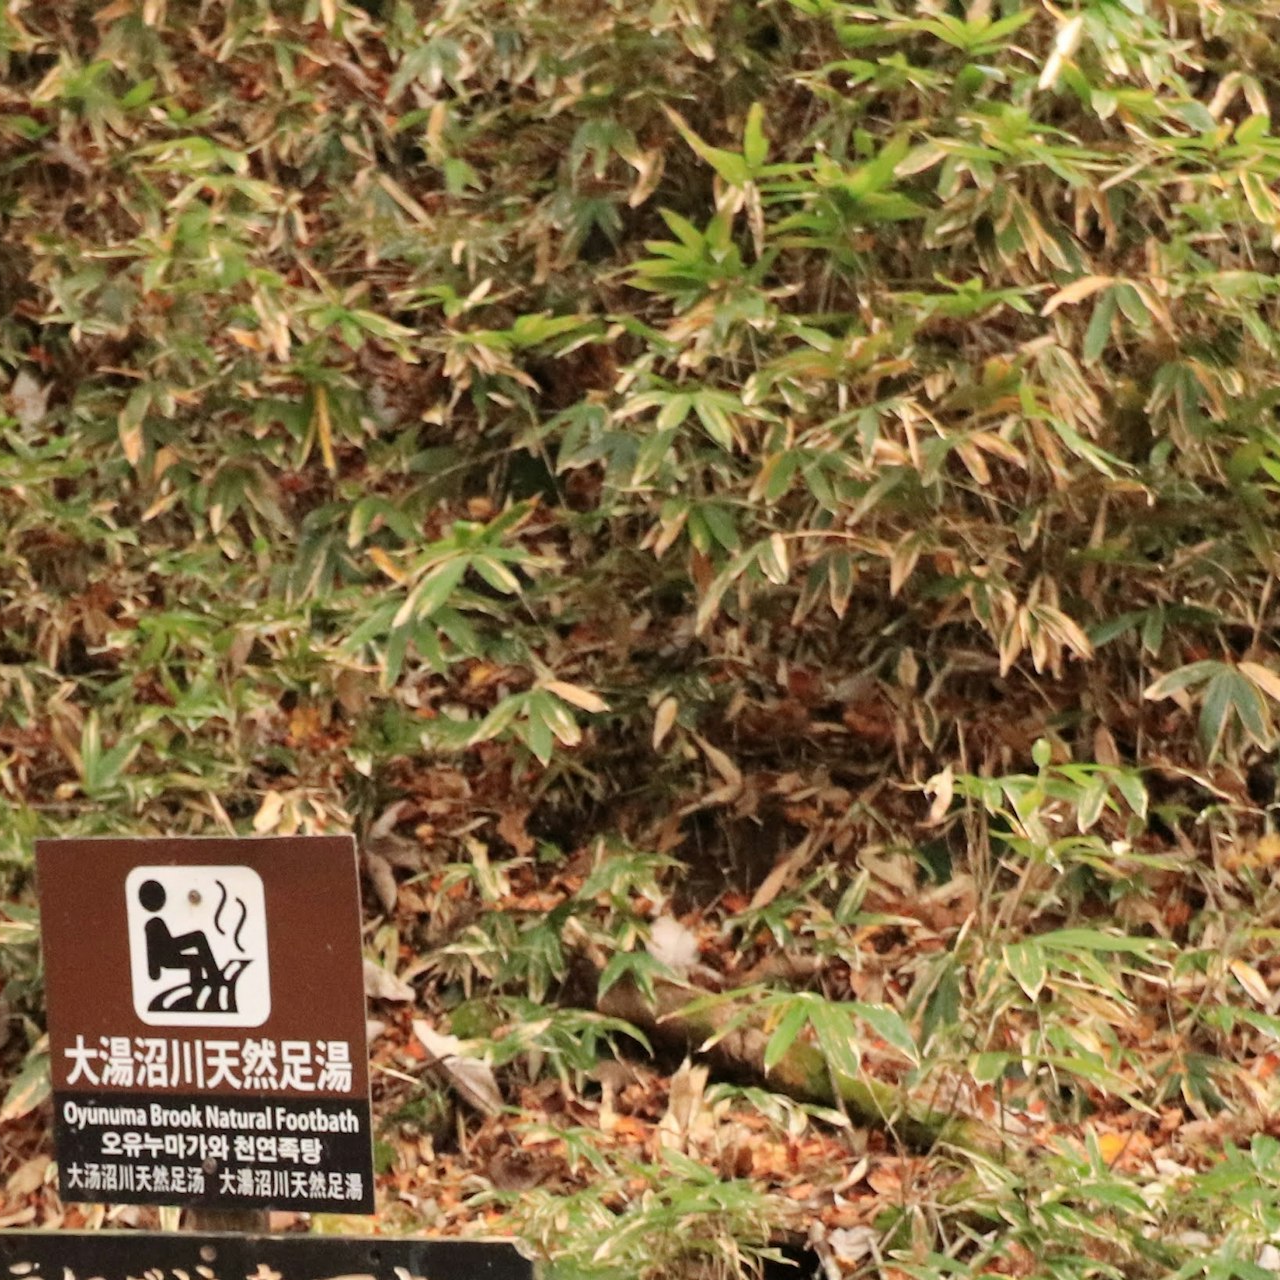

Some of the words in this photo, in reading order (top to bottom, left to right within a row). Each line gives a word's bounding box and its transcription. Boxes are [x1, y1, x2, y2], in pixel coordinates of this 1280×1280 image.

[64, 1035, 352, 1093] 大湯沼川天然足湯
[63, 1101, 147, 1129] Oyunuma
[150, 1103, 202, 1129] Brook
[206, 1105, 272, 1131] Natural
[275, 1107, 359, 1133] Footbath
[101, 1132, 228, 1161] 오유누마가와
[234, 1135, 323, 1164] 천연족탕
